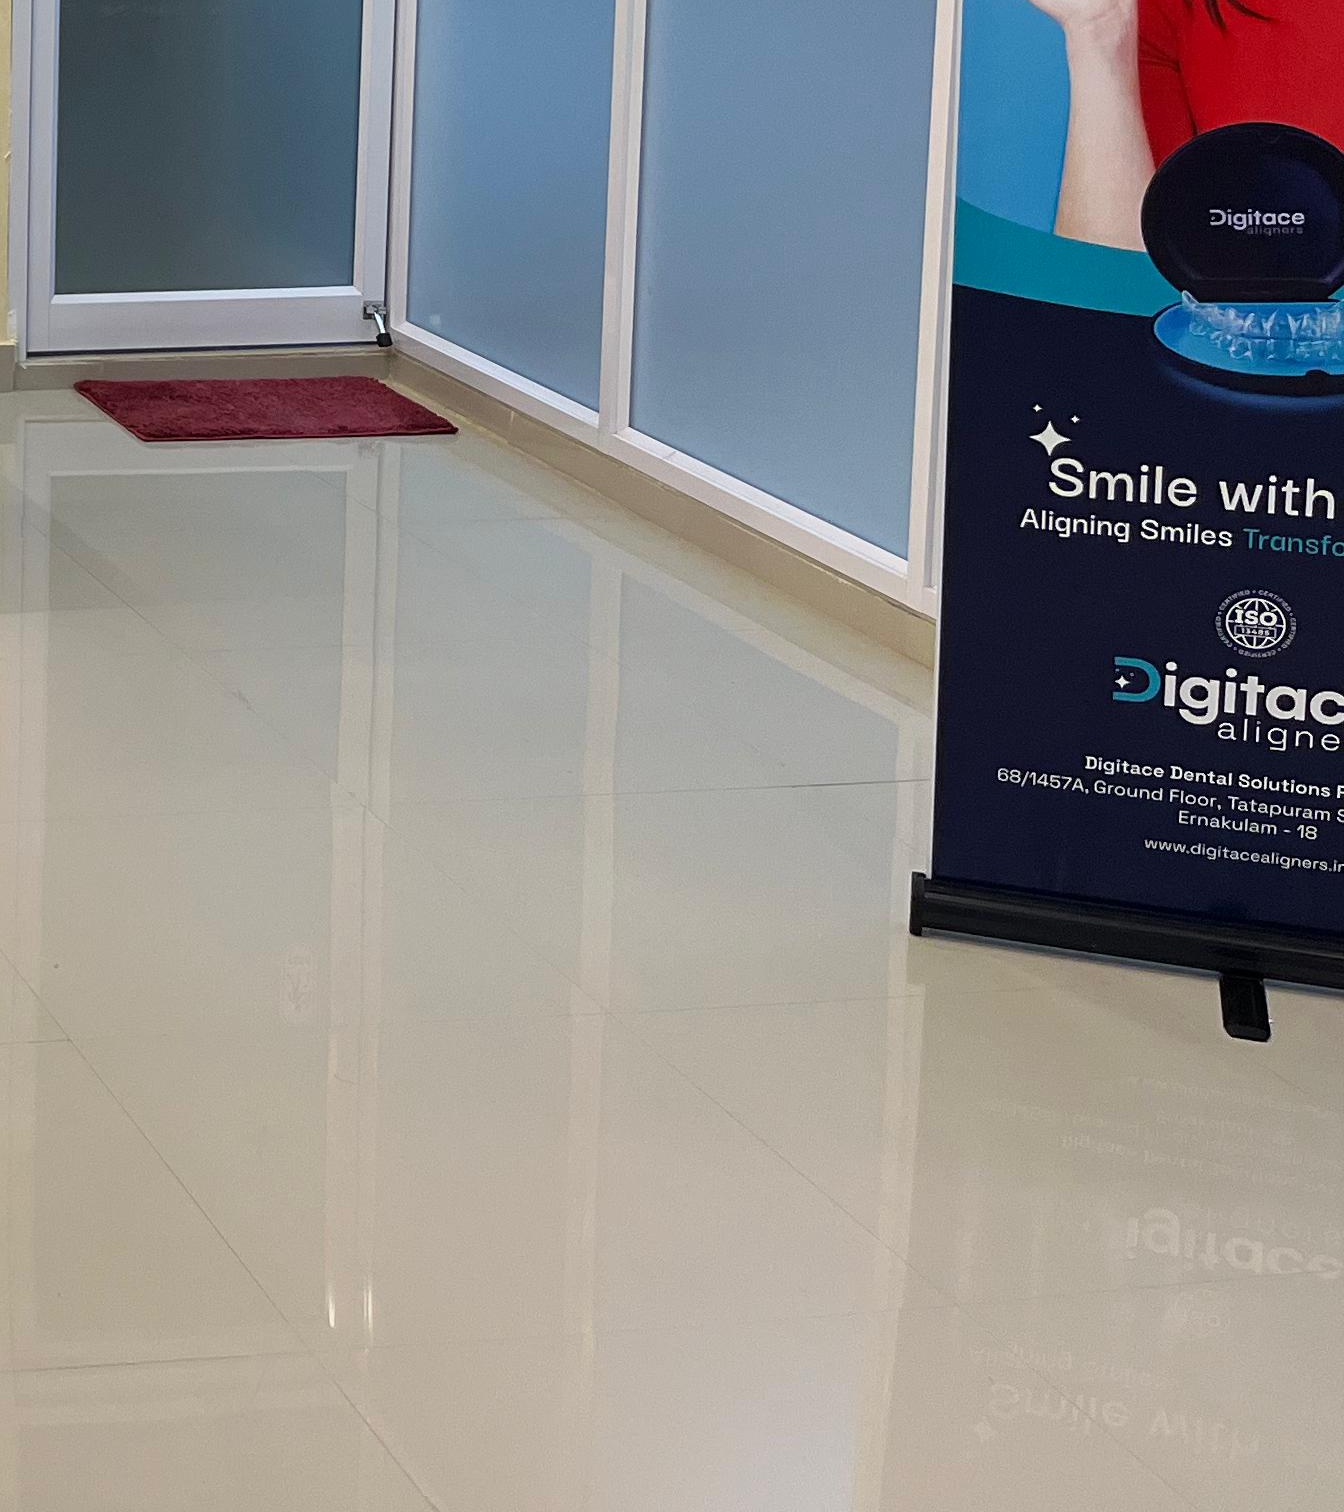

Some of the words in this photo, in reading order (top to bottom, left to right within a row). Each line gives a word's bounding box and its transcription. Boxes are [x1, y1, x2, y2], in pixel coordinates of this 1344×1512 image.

[1209, 208, 1305, 231] Digitace
[1048, 457, 1198, 507] Smile
[1219, 475, 1336, 520] with
[1020, 508, 1130, 543] Aligning
[1140, 519, 1233, 547] Smiles
[1234, 609, 1278, 627] ISO
[1113, 656, 1344, 726] Digitac
[1217, 718, 1340, 751] aligne
[997, 767, 1090, 794] 68/1457A,
[1094, 779, 1164, 802] Ground
[1169, 788, 1222, 811] Floor,
[1228, 795, 1331, 822] Tatapuram
[1084, 755, 1165, 778] Digitace
[1170, 765, 1233, 786] Dental
[1238, 774, 1331, 798] Solutions
[1178, 809, 1278, 835] Ernakulam
[1296, 824, 1318, 840] 18
